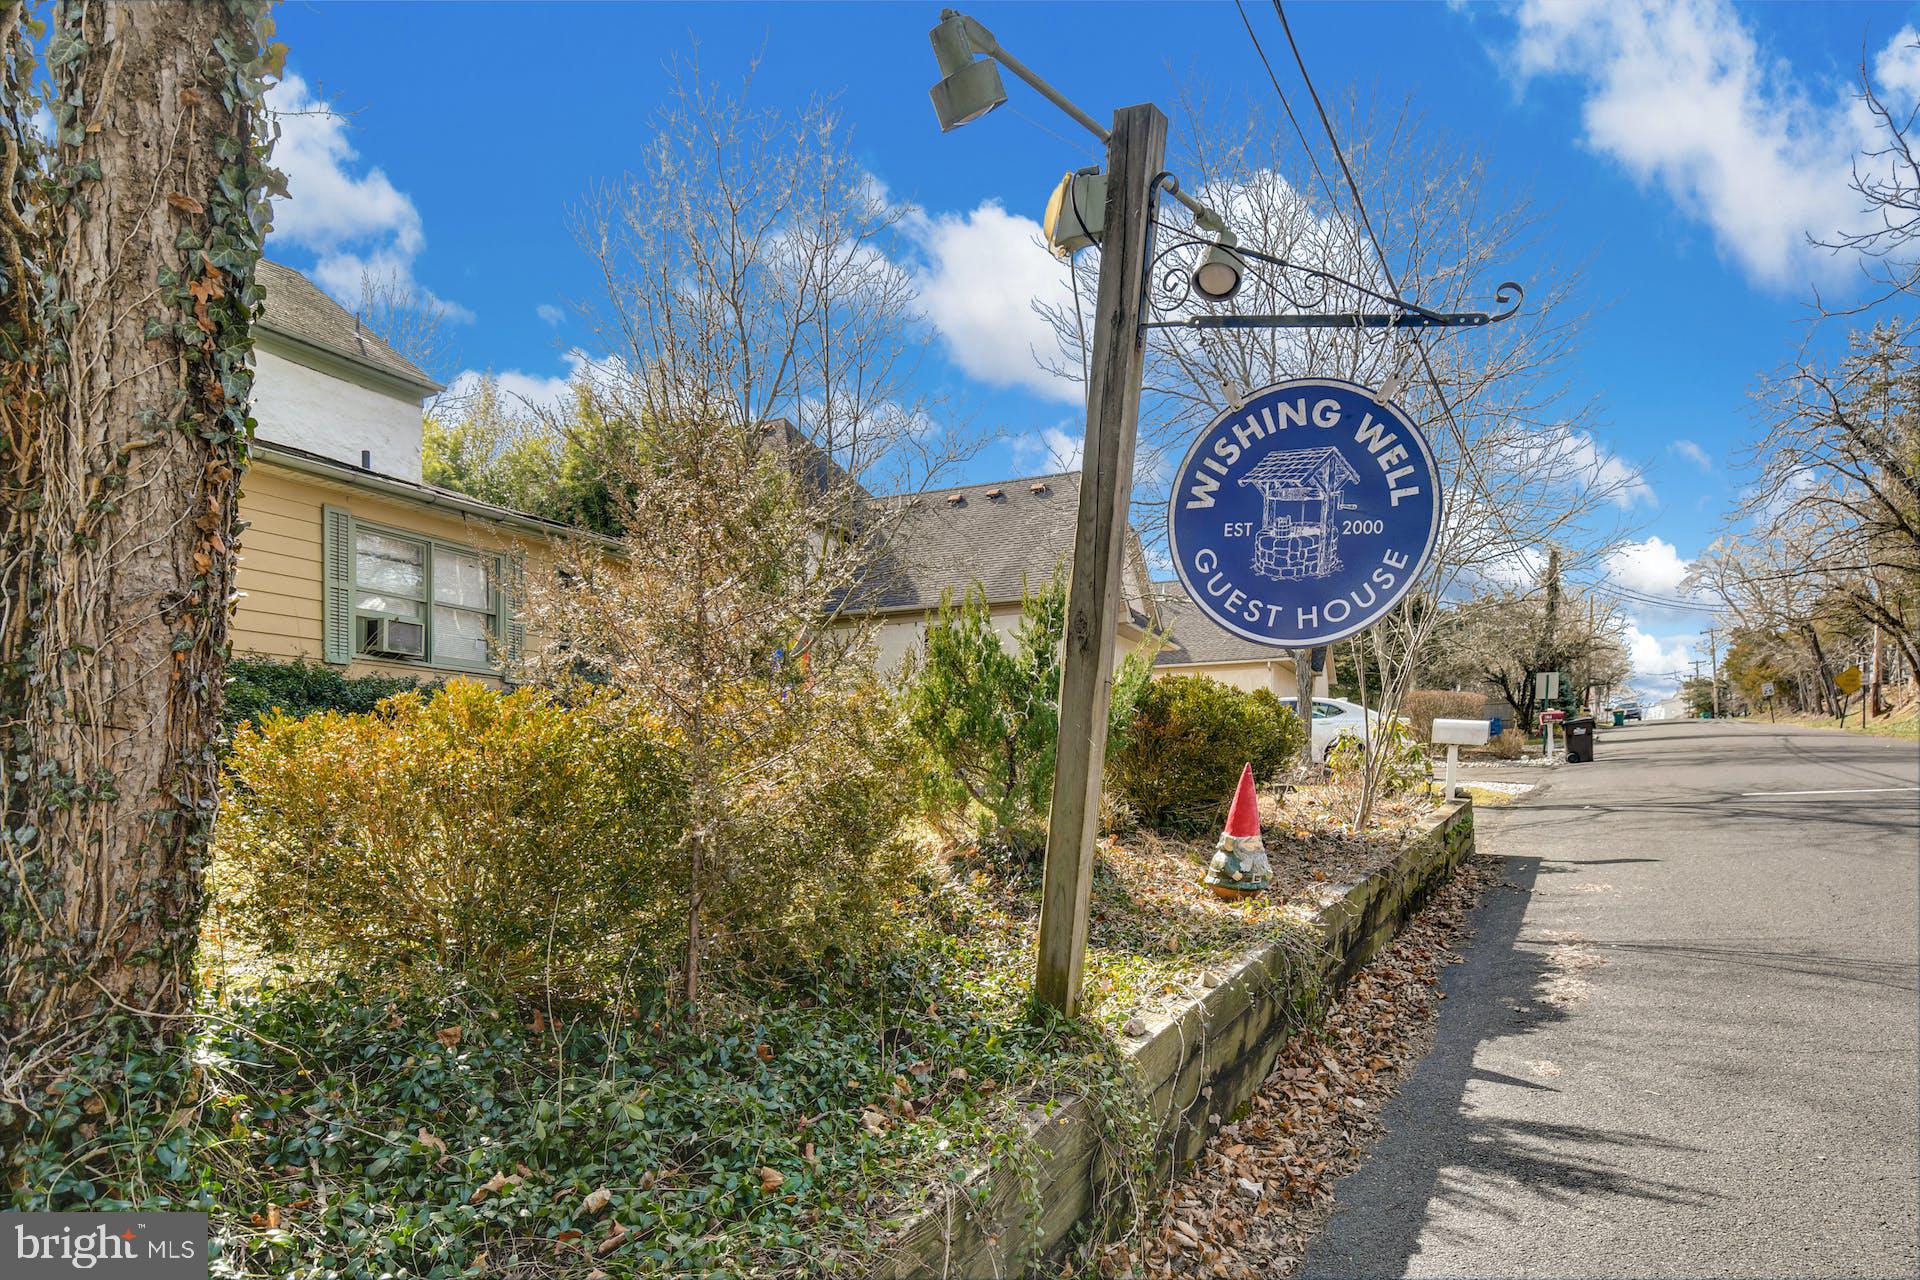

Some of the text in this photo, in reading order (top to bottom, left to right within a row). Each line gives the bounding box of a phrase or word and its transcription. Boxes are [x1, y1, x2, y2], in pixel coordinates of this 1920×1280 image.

[1186, 398, 1420, 510] WISHING WELL
[1223, 519, 1384, 537] EST 2000
[1194, 548, 1409, 629] GUEST HOUSE
